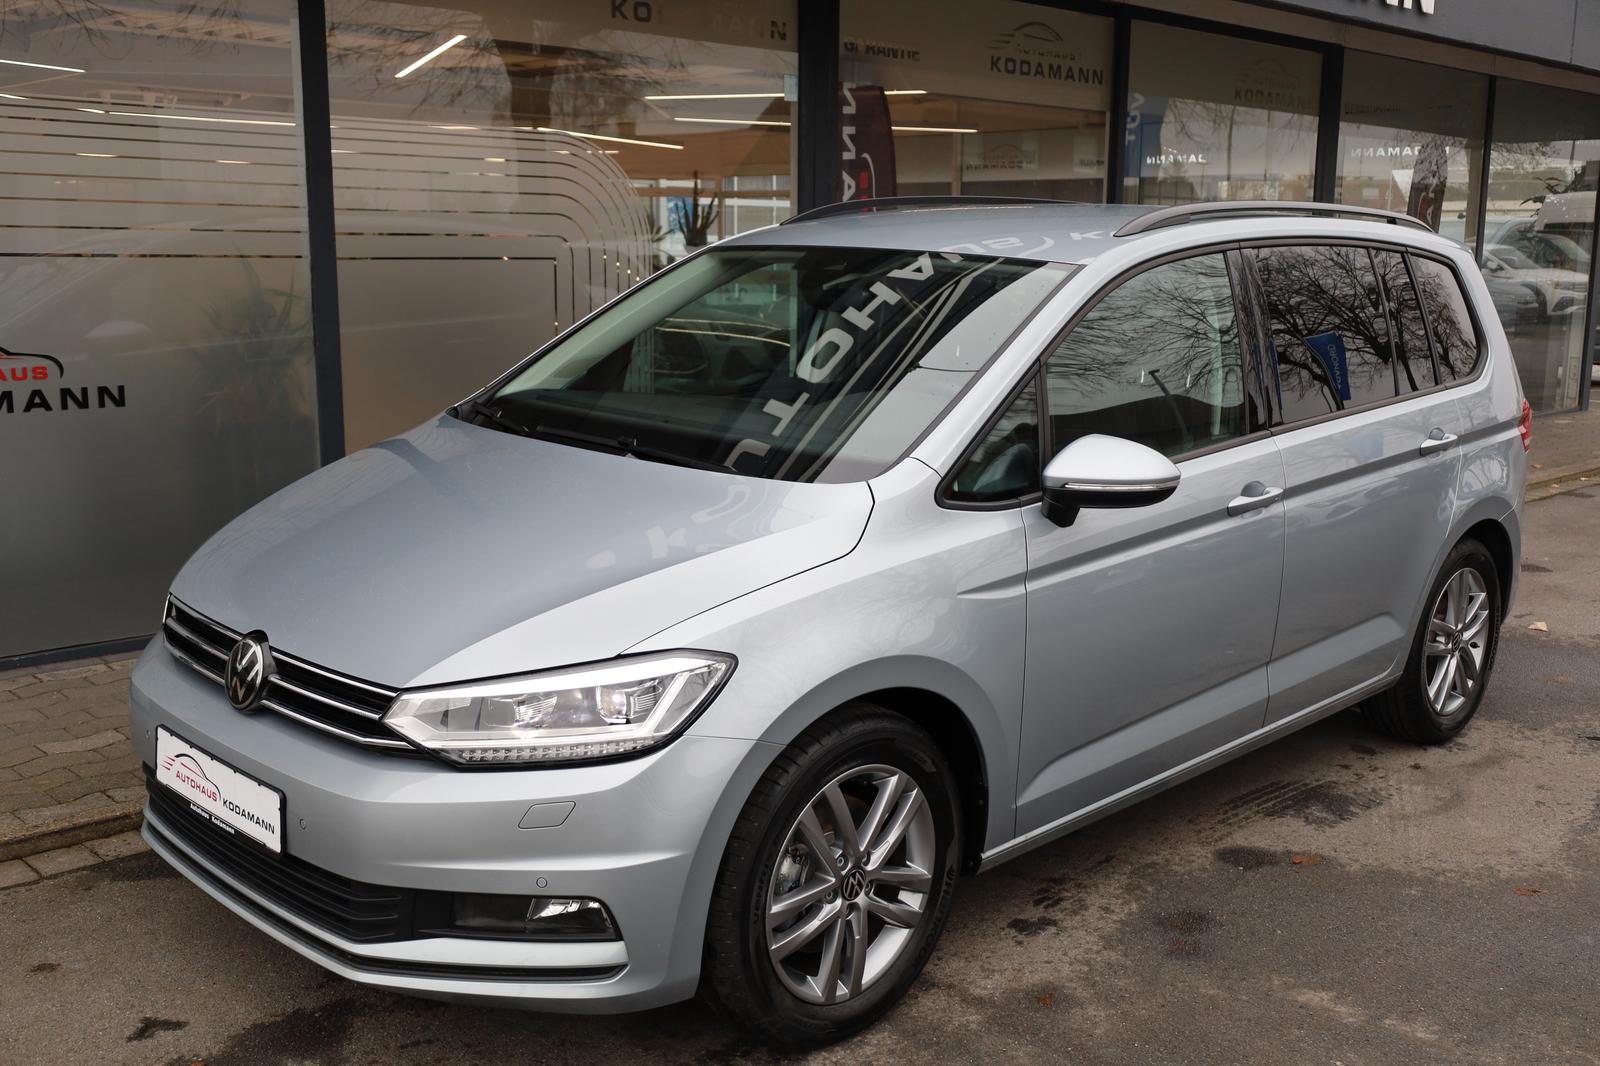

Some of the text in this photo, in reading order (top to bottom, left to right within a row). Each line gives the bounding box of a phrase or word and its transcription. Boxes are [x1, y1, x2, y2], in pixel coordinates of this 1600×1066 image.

[990, 55, 1104, 86] KODAMANN
[175, 770, 218, 802] AUTOHAUS
[222, 797, 276, 835] KODAMANN
